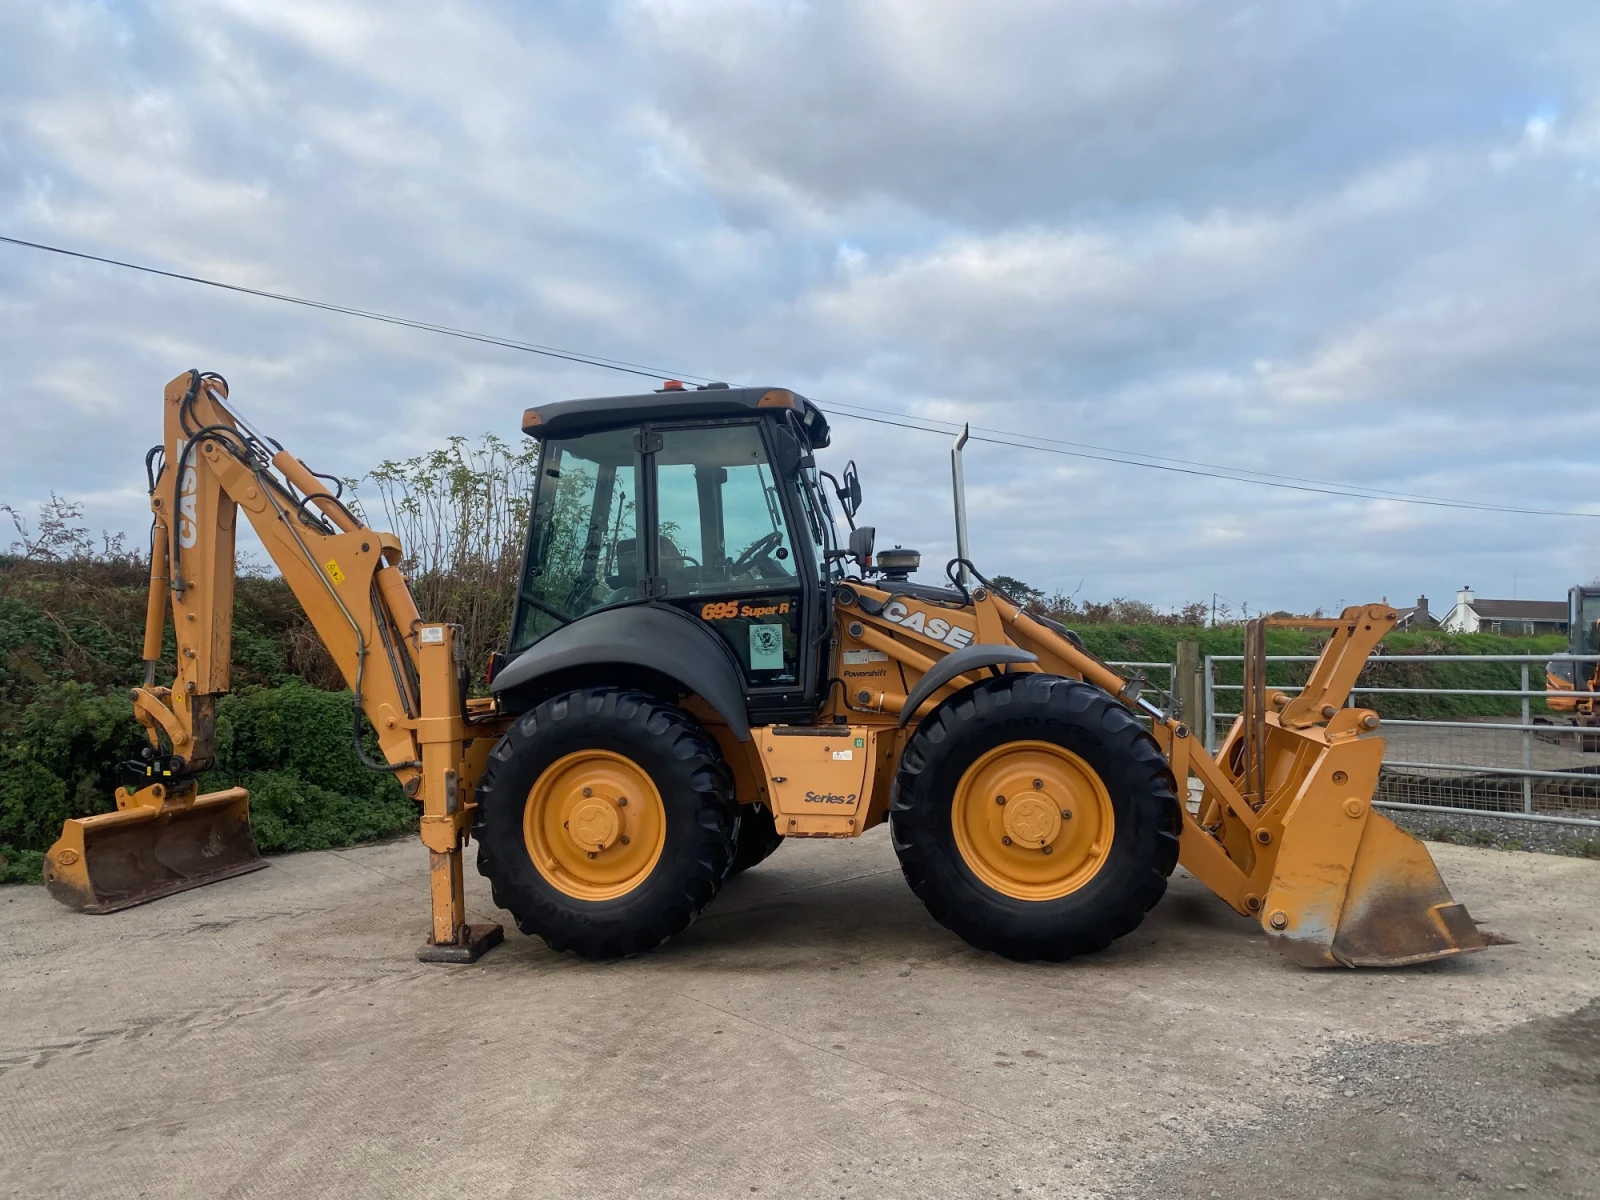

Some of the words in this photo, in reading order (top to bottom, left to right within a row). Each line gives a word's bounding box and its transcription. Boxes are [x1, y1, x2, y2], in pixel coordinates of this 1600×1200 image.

[701, 601, 739, 620] 695
[740, 605, 778, 618] Super
[778, 602, 790, 614] R
[882, 601, 976, 650] CASE
[843, 669, 887, 678] Powershift
[804, 790, 846, 805] Series
[845, 793, 857, 805] 2
